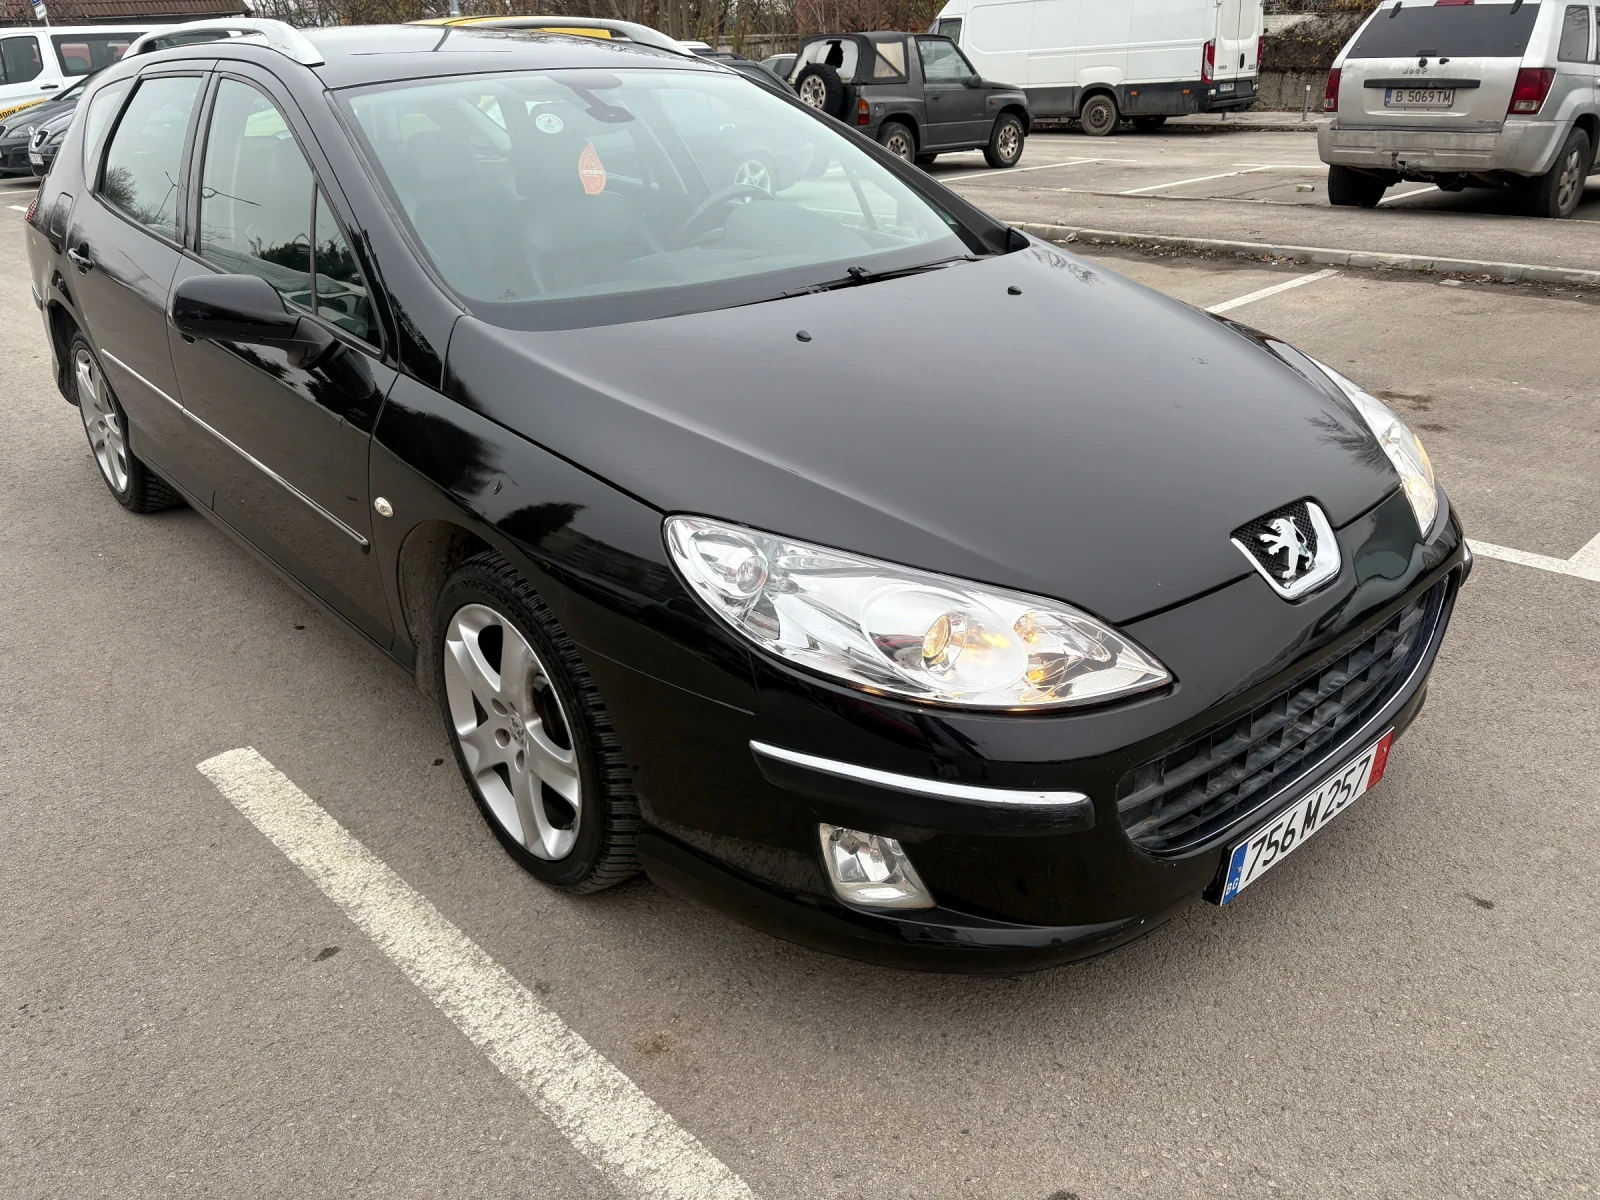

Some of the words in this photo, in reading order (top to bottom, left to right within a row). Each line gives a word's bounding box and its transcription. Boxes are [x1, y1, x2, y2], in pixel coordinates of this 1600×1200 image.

[1396, 91, 1403, 102] B
[1408, 91, 1434, 102] 5069
[1437, 91, 1451, 102] TM
[1226, 877, 1239, 895] BG
